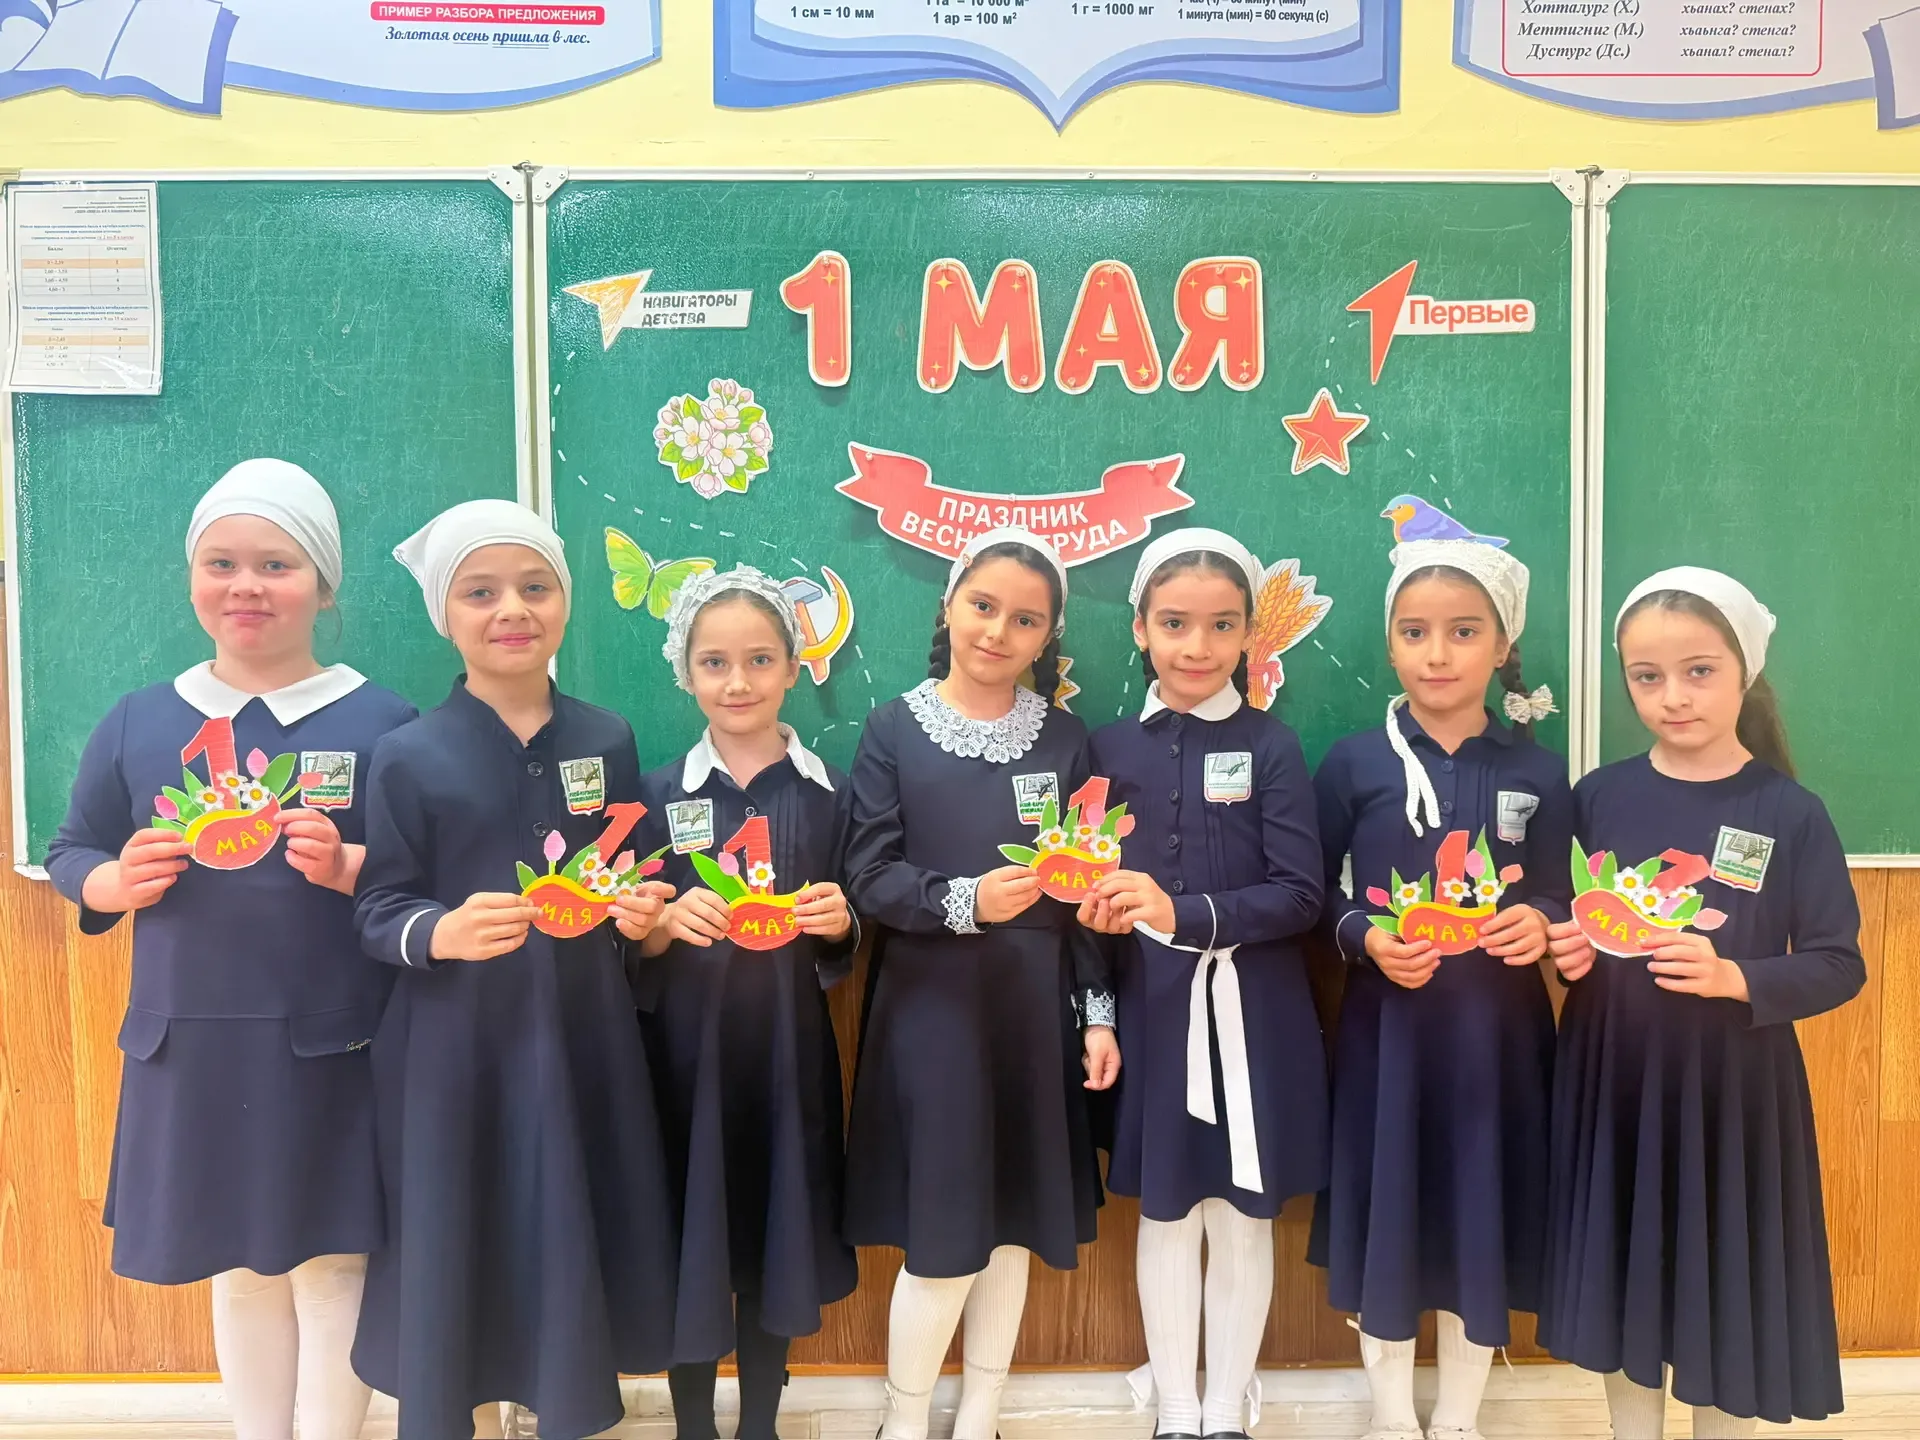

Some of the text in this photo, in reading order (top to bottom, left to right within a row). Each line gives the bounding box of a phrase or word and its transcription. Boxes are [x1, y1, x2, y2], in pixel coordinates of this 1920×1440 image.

[378, 5, 597, 21] ПРИМЕР РАЗБОРА ПРЕДЛОЖЕНИЯ
[790, 6, 875, 19] 1 см = 10 мм
[1071, 4, 1078, 15] 1
[1082, 7, 1088, 15] г
[1104, 4, 1134, 16] 1000
[1138, 6, 1154, 16] мг
[1177, 8, 1183, 19] 1
[1186, 10, 1223, 22] минута
[1225, 9, 1253, 22] (мин)
[1264, 9, 1276, 20] 60
[1278, 11, 1314, 22] секунд
[1316, 10, 1329, 23] (с)
[1521, 0, 1640, 16] Хотталург (Х.)
[1681, 2, 1795, 14] хьанах? стенах?
[932, 12, 939, 24] 1
[943, 14, 960, 26] ар
[976, 12, 999, 24] 100
[385, 26, 591, 45] Золотая осень пришла в лес.
[1517, 22, 1645, 38] Меттигниг (М.)
[1679, 24, 1796, 37] хьаьнга? стенга?
[1526, 44, 1631, 60] Дустург (Дс.)
[1680, 45, 1795, 58] хьанал? стенал?
[642, 294, 738, 309] НАВИГАТОРЫ
[641, 312, 706, 327] ДЕТСТВА
[783, 252, 1263, 393] 1 МАЯ
[1409, 299, 1529, 332] Первые
[938, 497, 1089, 532] ПРАЗДНИК
[899, 510, 984, 549] ВЕСН
[181, 716, 238, 809] 1
[1067, 776, 1110, 852] 1
[216, 819, 273, 856] МАЯ
[582, 802, 648, 888] 1
[723, 816, 774, 895] 1
[1434, 830, 1470, 907] 1
[540, 901, 592, 926] МАЯ
[1414, 923, 1477, 942] МАЯ
